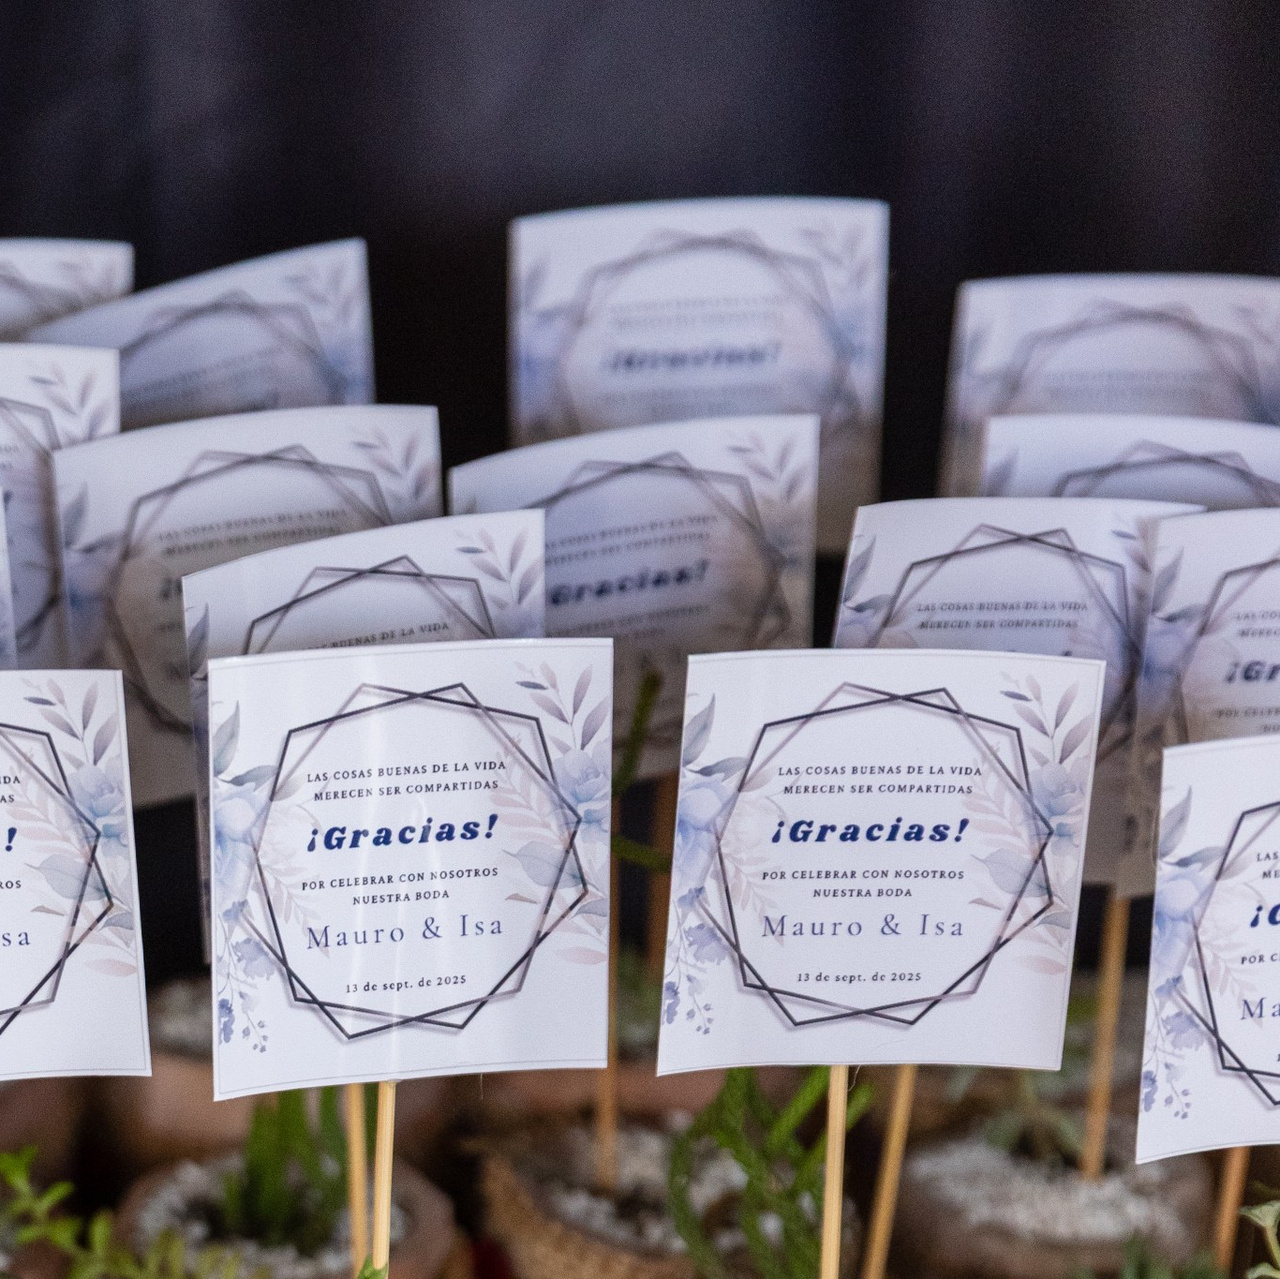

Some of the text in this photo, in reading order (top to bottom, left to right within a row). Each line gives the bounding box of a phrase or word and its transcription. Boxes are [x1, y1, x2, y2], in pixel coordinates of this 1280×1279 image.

[549, 558, 709, 606] Gracias!
[306, 760, 506, 783] LAS COSAS BUENAS DE LA VIDA
[777, 764, 982, 776] LAS COSAS BUENAS DE LA VIDA
[313, 779, 499, 802] MERECEN SER COMPARTIDAS
[782, 783, 973, 795] MERECEN SER COMPARTIDAS
[306, 812, 499, 852] ¡Gracias!
[770, 816, 970, 843] ¡Gracias!
[1257, 852, 1279, 862] LAS
[301, 866, 498, 891] POR CELEBRAR CON NOSOTROS
[761, 869, 964, 881] POR CELEBRAR CON NOSOTROS
[352, 889, 450, 906] NUESTRA BODA
[812, 887, 912, 898] NUESTRA BODA
[306, 914, 503, 949] Mauro & Isa
[761, 913, 963, 937] Mauro & Isa
[1241, 954, 1266, 966] POR
[345, 974, 466, 994] 13 de sept. de 2025
[796, 971, 922, 984] 13 de sept. de 2025
